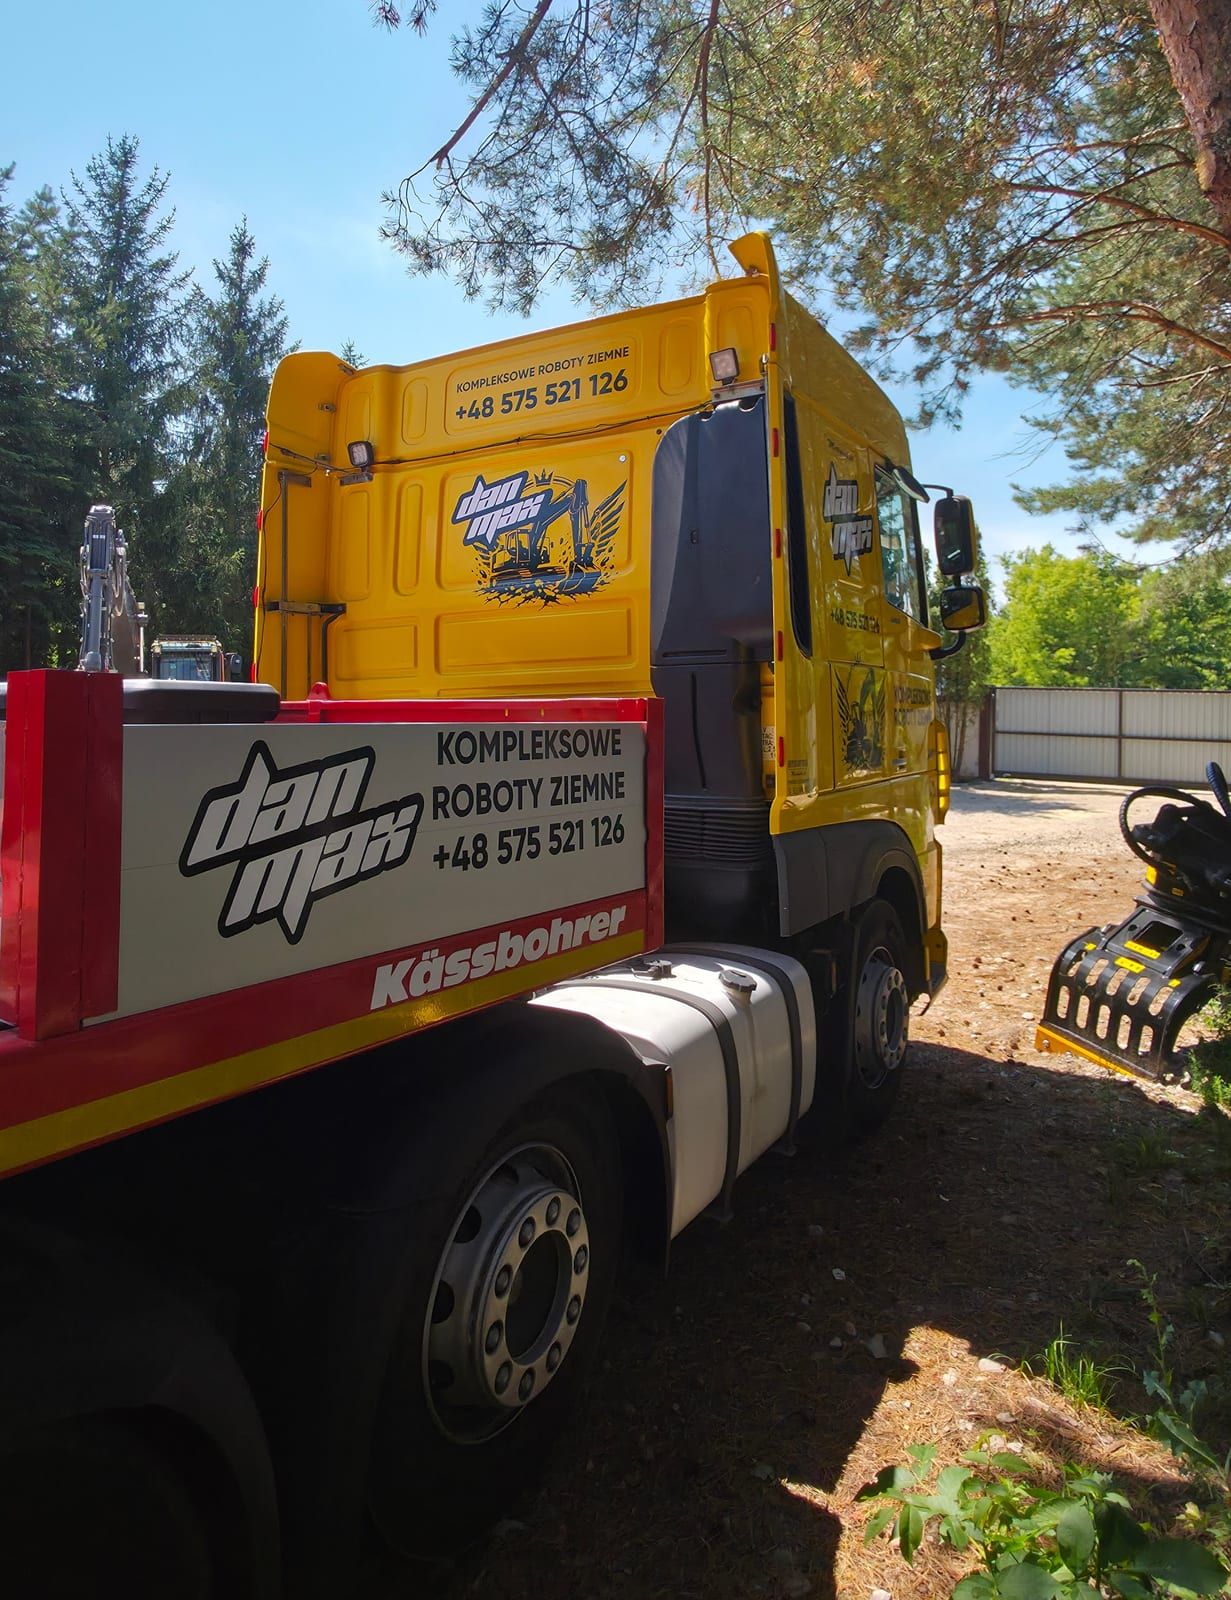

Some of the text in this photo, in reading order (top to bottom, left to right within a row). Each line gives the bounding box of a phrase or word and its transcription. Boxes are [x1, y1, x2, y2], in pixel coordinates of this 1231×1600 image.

[455, 368, 629, 420] +48 575 521 126
[456, 346, 630, 393] KOMPLEKSOWE ROBOTY ZIEMNE
[436, 728, 622, 766] KOMPLEKSOWE
[432, 771, 626, 820] ROBOTY ZIEMNE
[432, 813, 626, 871] +48 575 521 126
[369, 904, 627, 1011] Kässbohrer
